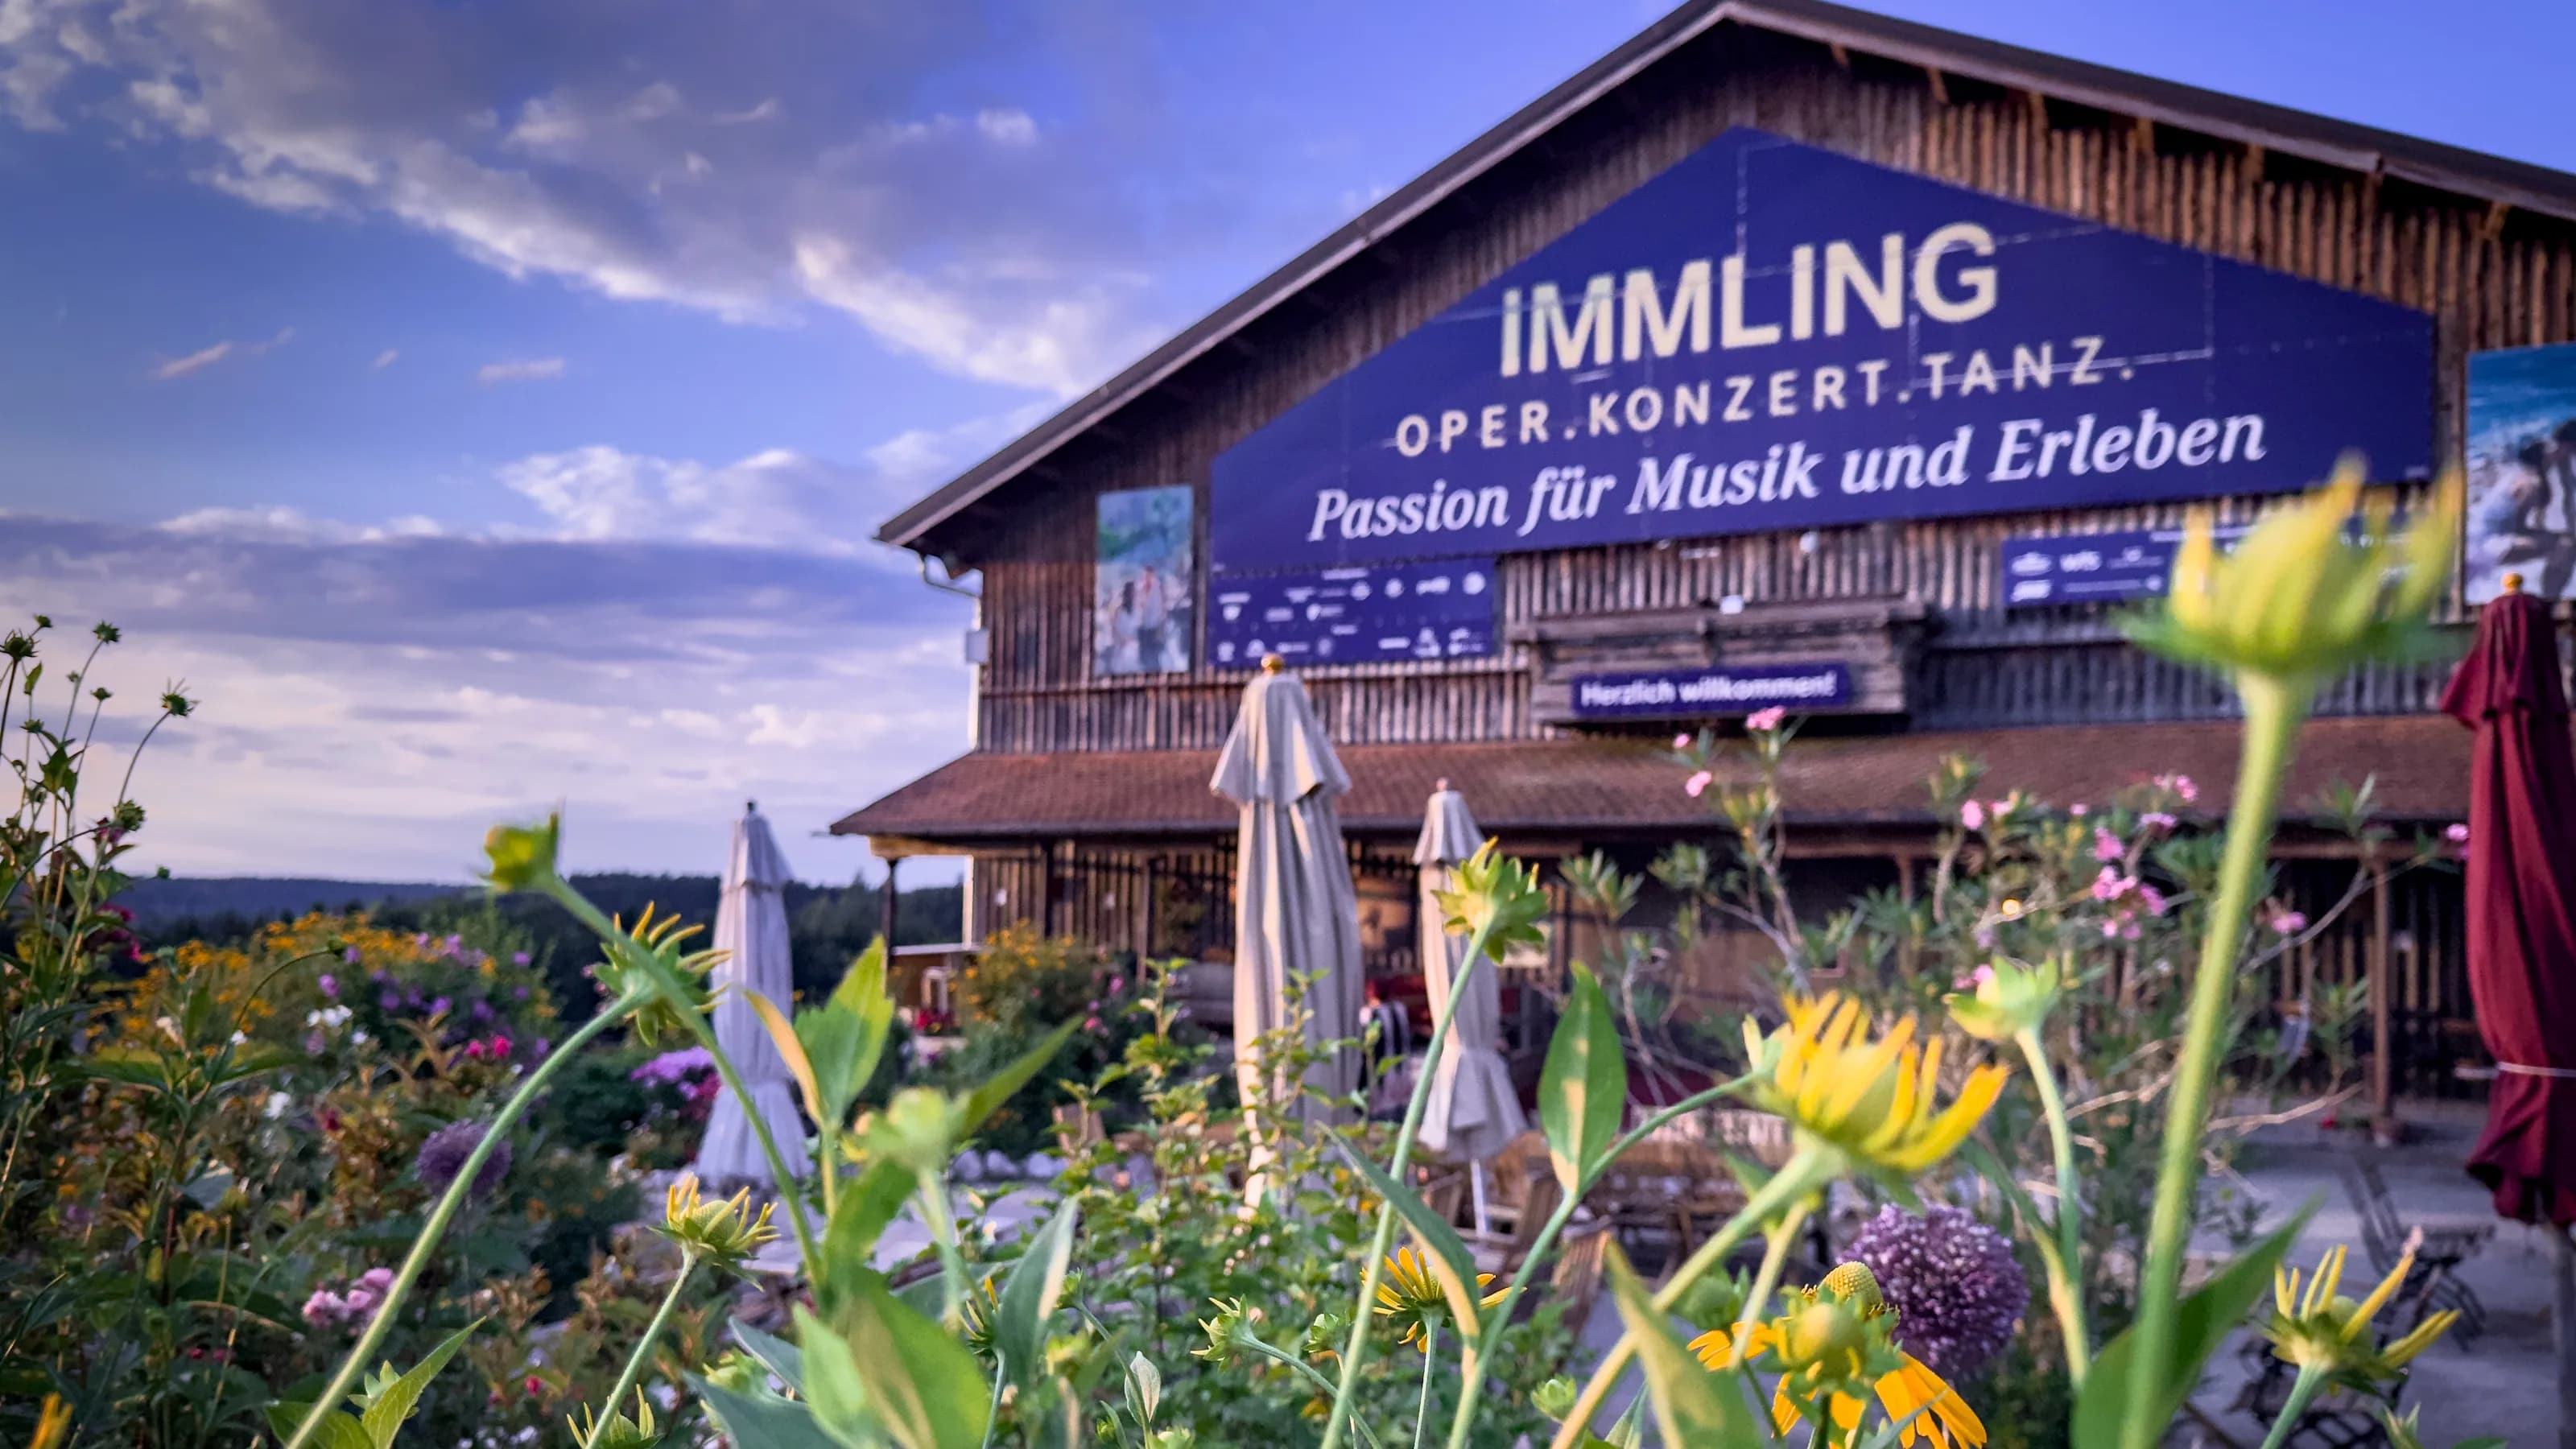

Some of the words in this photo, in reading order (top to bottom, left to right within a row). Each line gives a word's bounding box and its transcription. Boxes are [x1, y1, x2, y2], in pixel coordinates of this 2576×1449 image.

[1501, 221, 1997, 378] IMMLING
[1308, 478, 1510, 541] Passion
[1517, 464, 1617, 536] für
[1626, 442, 1823, 515] Musik
[1840, 425, 1975, 495] und
[1988, 408, 2268, 483] Erleben
[1581, 679, 1676, 707] Herzlich
[1678, 671, 1839, 702] willkommen!
